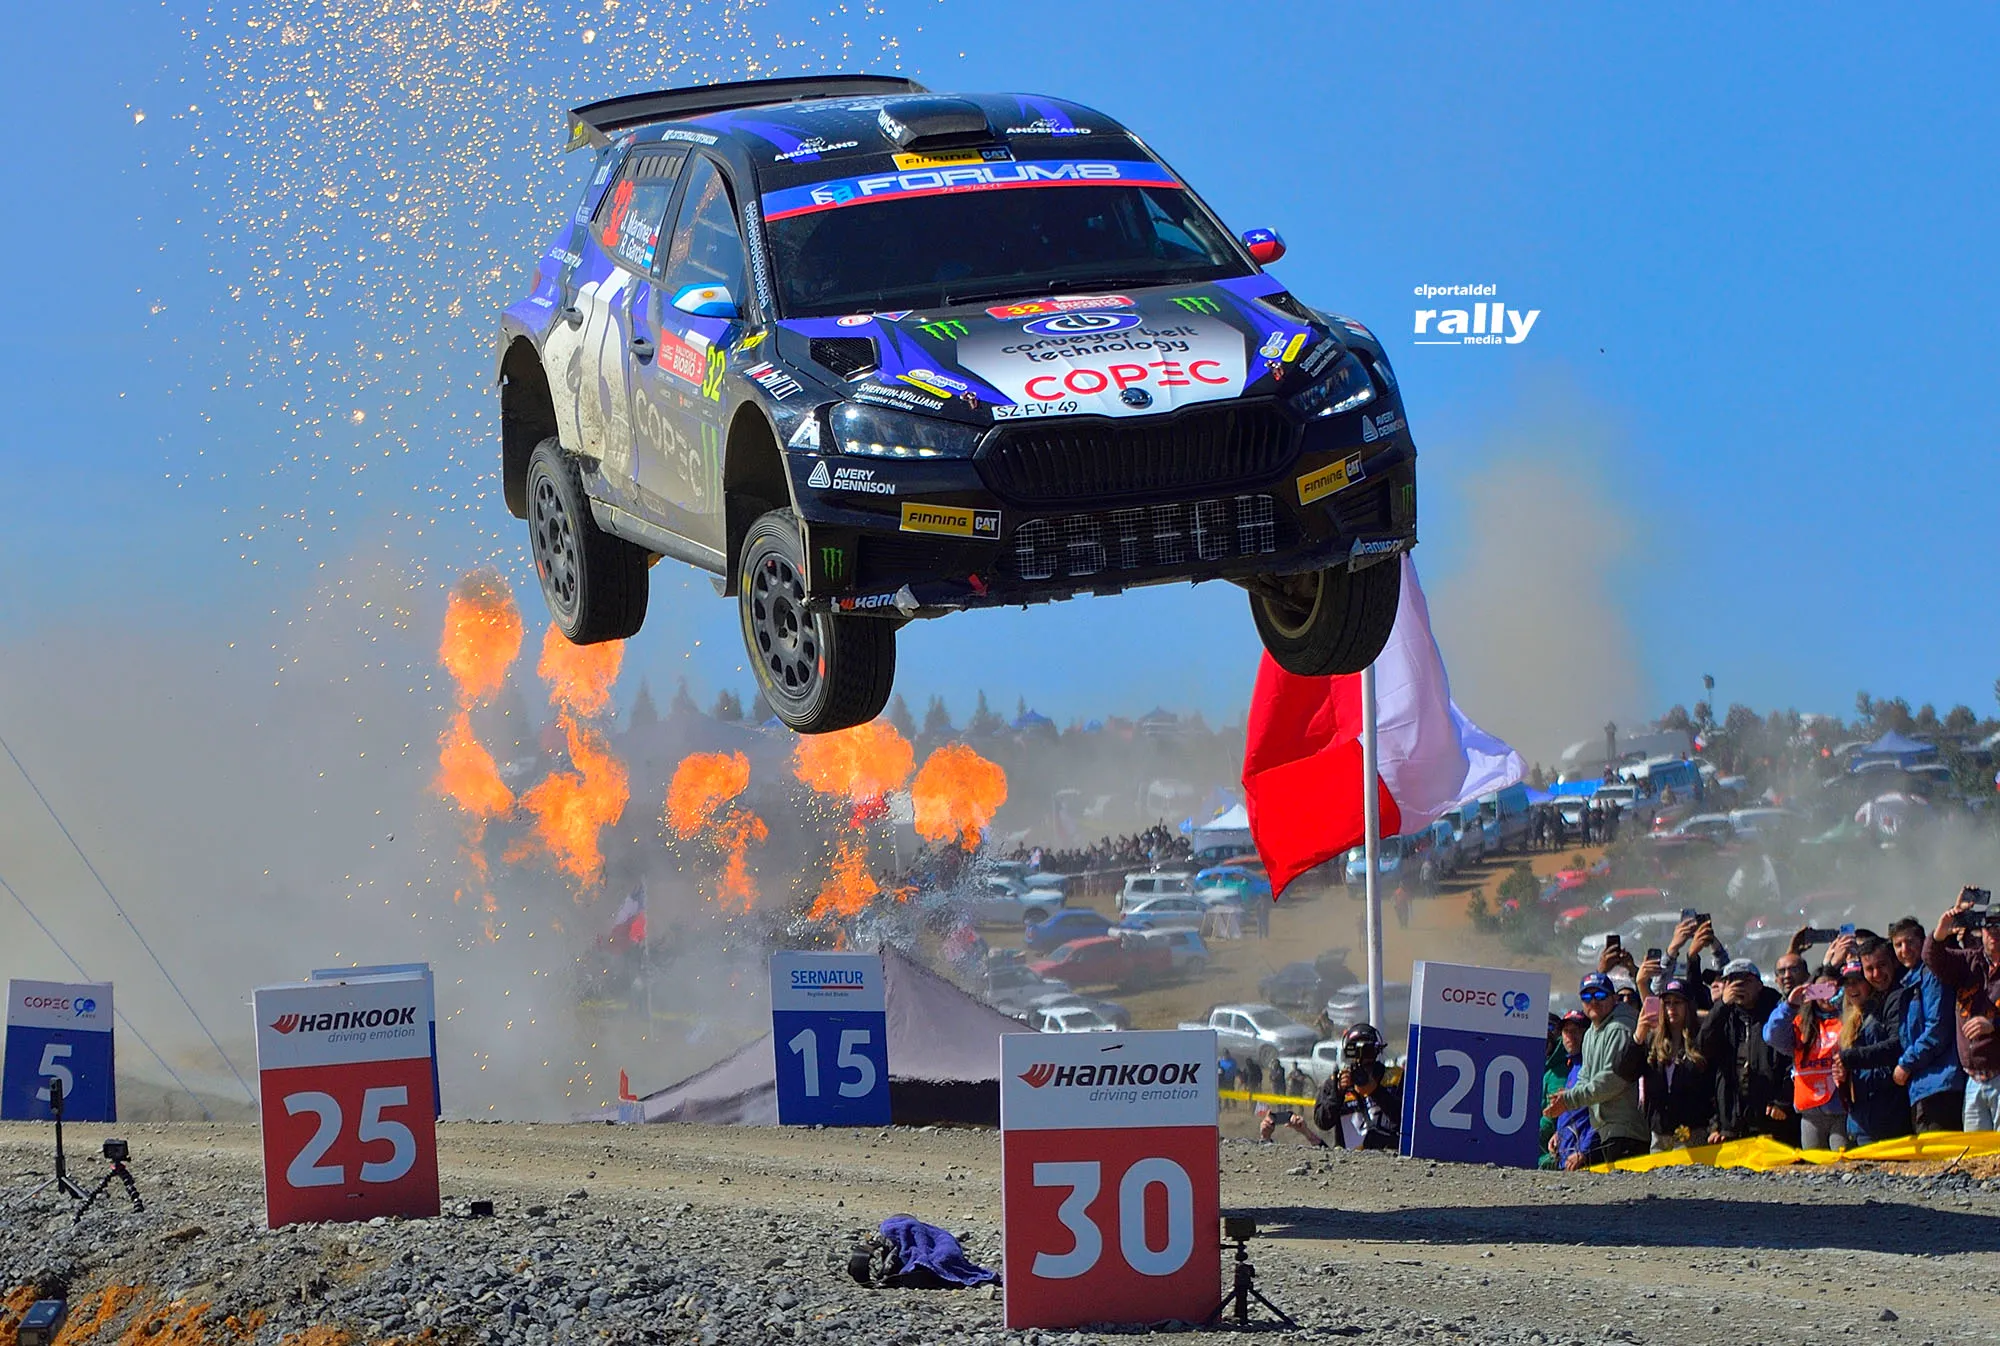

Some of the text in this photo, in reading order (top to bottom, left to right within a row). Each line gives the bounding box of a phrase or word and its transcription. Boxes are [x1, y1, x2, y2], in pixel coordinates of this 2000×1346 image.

[859, 163, 1121, 196] FORUM8
[1007, 305, 1045, 315] 32
[1139, 325, 1201, 338] belt
[1025, 338, 1191, 362] technology
[703, 345, 726, 402] 32
[743, 361, 791, 389] Mobil
[1024, 360, 1230, 402] COPEC
[857, 383, 944, 410] SHERWIN-WILLIAMS
[635, 388, 703, 497] COPEC
[834, 467, 876, 481] AVERY
[1346, 459, 1360, 476] CAT
[833, 478, 896, 495] DENNISON
[1304, 469, 1345, 492] FINNING
[908, 513, 968, 527] FINNING
[975, 516, 998, 531] CAT
[791, 970, 864, 984] SERNATUR
[24, 996, 70, 1010] COPEC
[1442, 988, 1497, 1006] COPEC
[327, 1027, 416, 1043] driving emotion
[35, 1043, 74, 1102] 5
[787, 1027, 877, 1099] 15
[1089, 1087, 1198, 1103] driving emotion
[1429, 1049, 1530, 1135] 20
[283, 1085, 417, 1188] 25
[1031, 1157, 1194, 1279] 30
